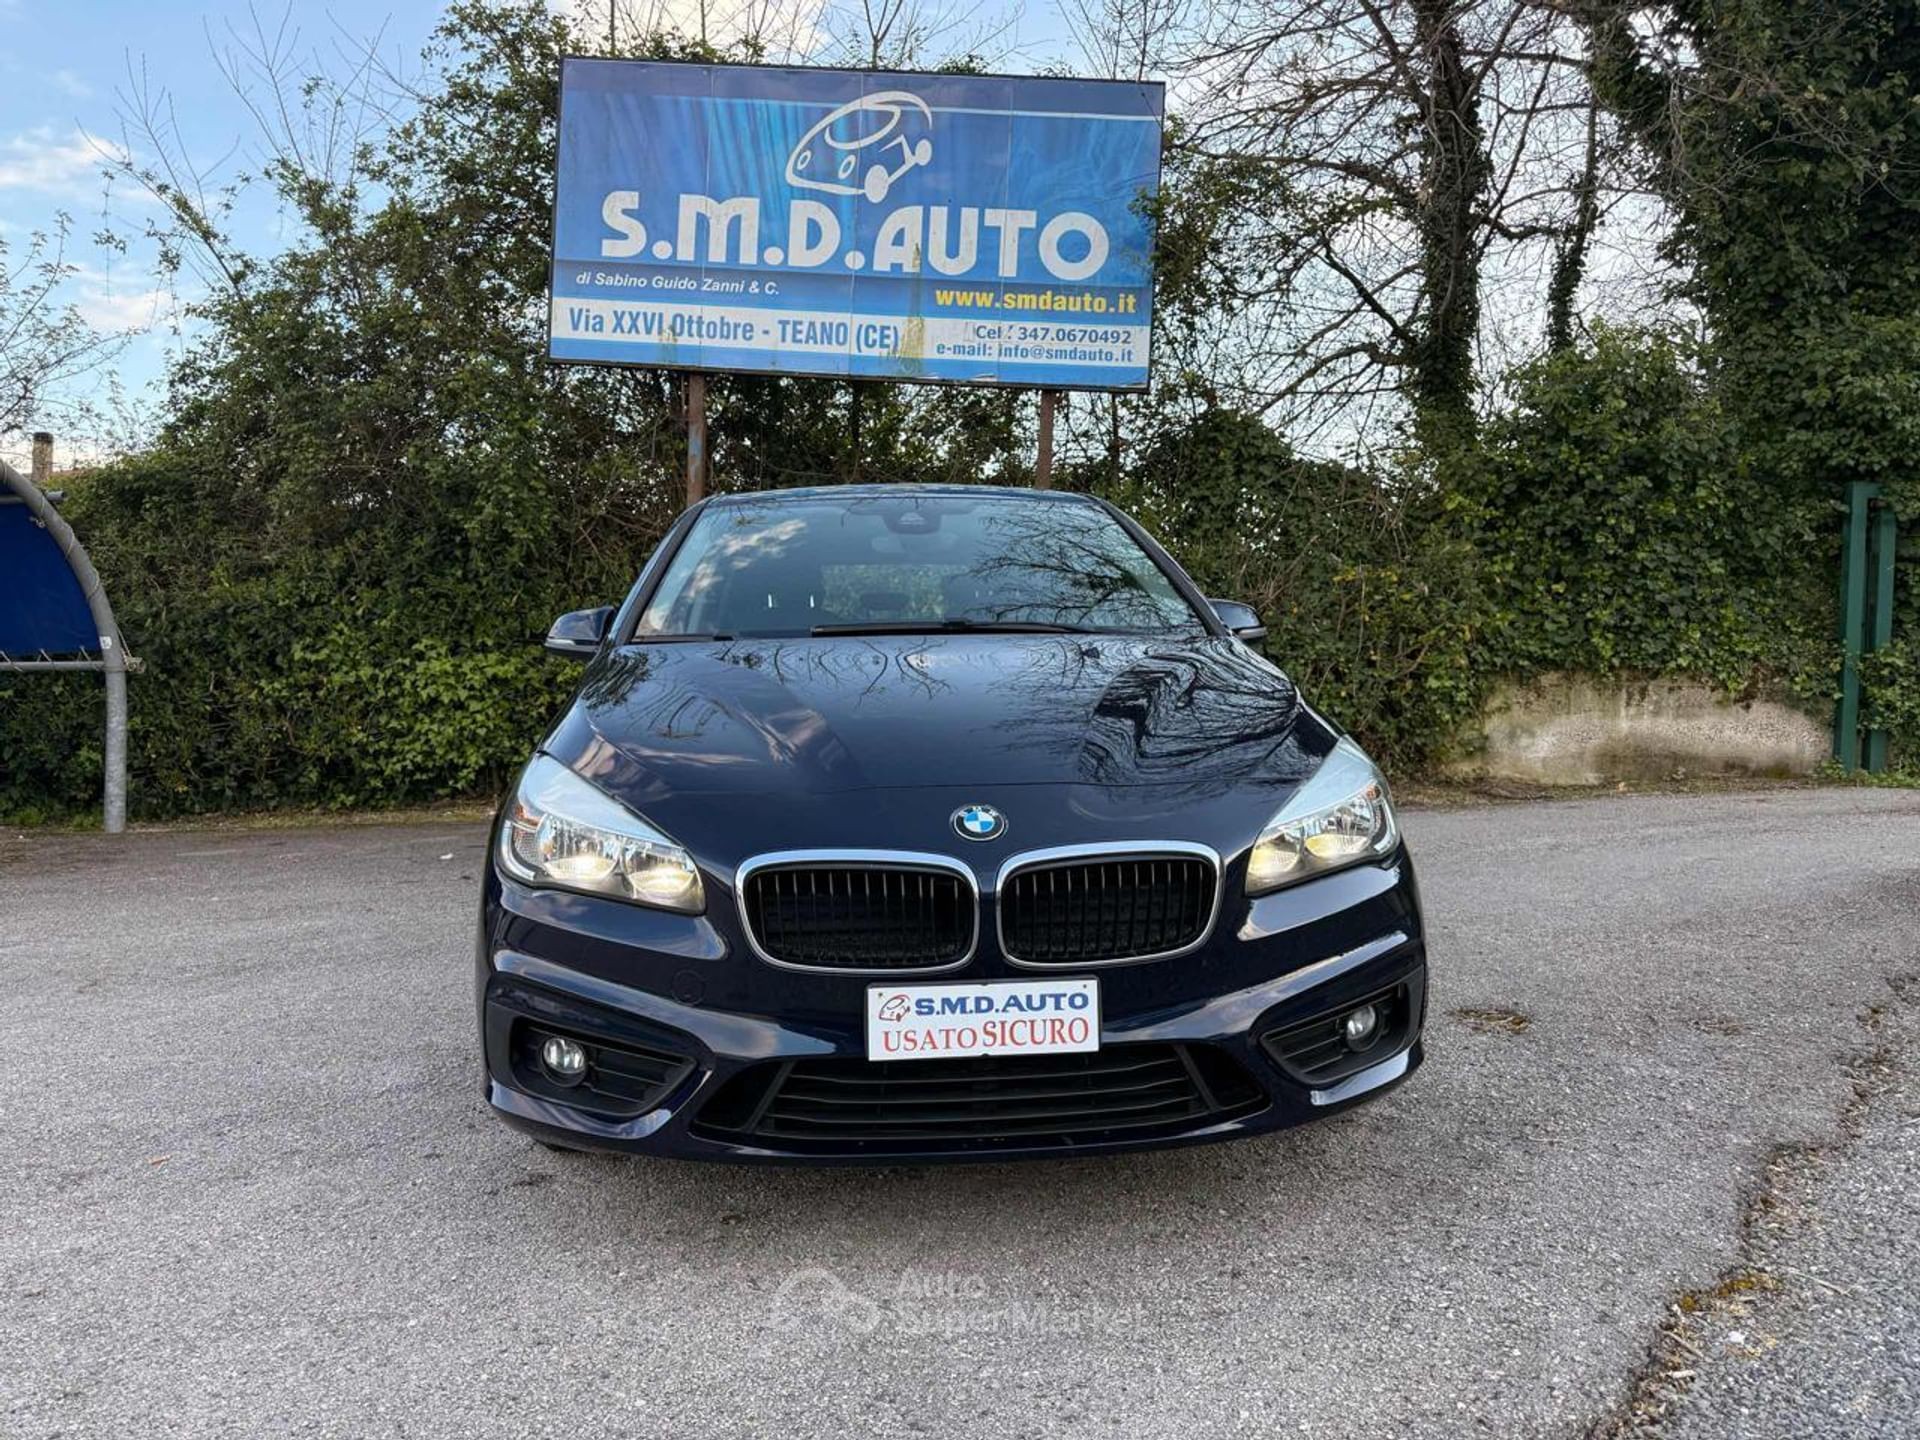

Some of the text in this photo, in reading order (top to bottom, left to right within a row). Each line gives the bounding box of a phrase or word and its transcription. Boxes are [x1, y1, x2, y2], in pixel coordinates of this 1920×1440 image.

[576, 271, 780, 295] di Sabino Guido Zanni & C.
[935, 290, 1137, 313] www.smdauto.it
[569, 307, 605, 333] Via
[611, 309, 664, 336] XXVI
[671, 312, 755, 341] Ottobre
[777, 319, 849, 346] TEANO
[856, 323, 899, 354] (CE)
[1018, 326, 1132, 344] 347.0670492
[935, 341, 1134, 362] e-mail: info@smdauto.it
[882, 1017, 1090, 1052] USATO SICURO
